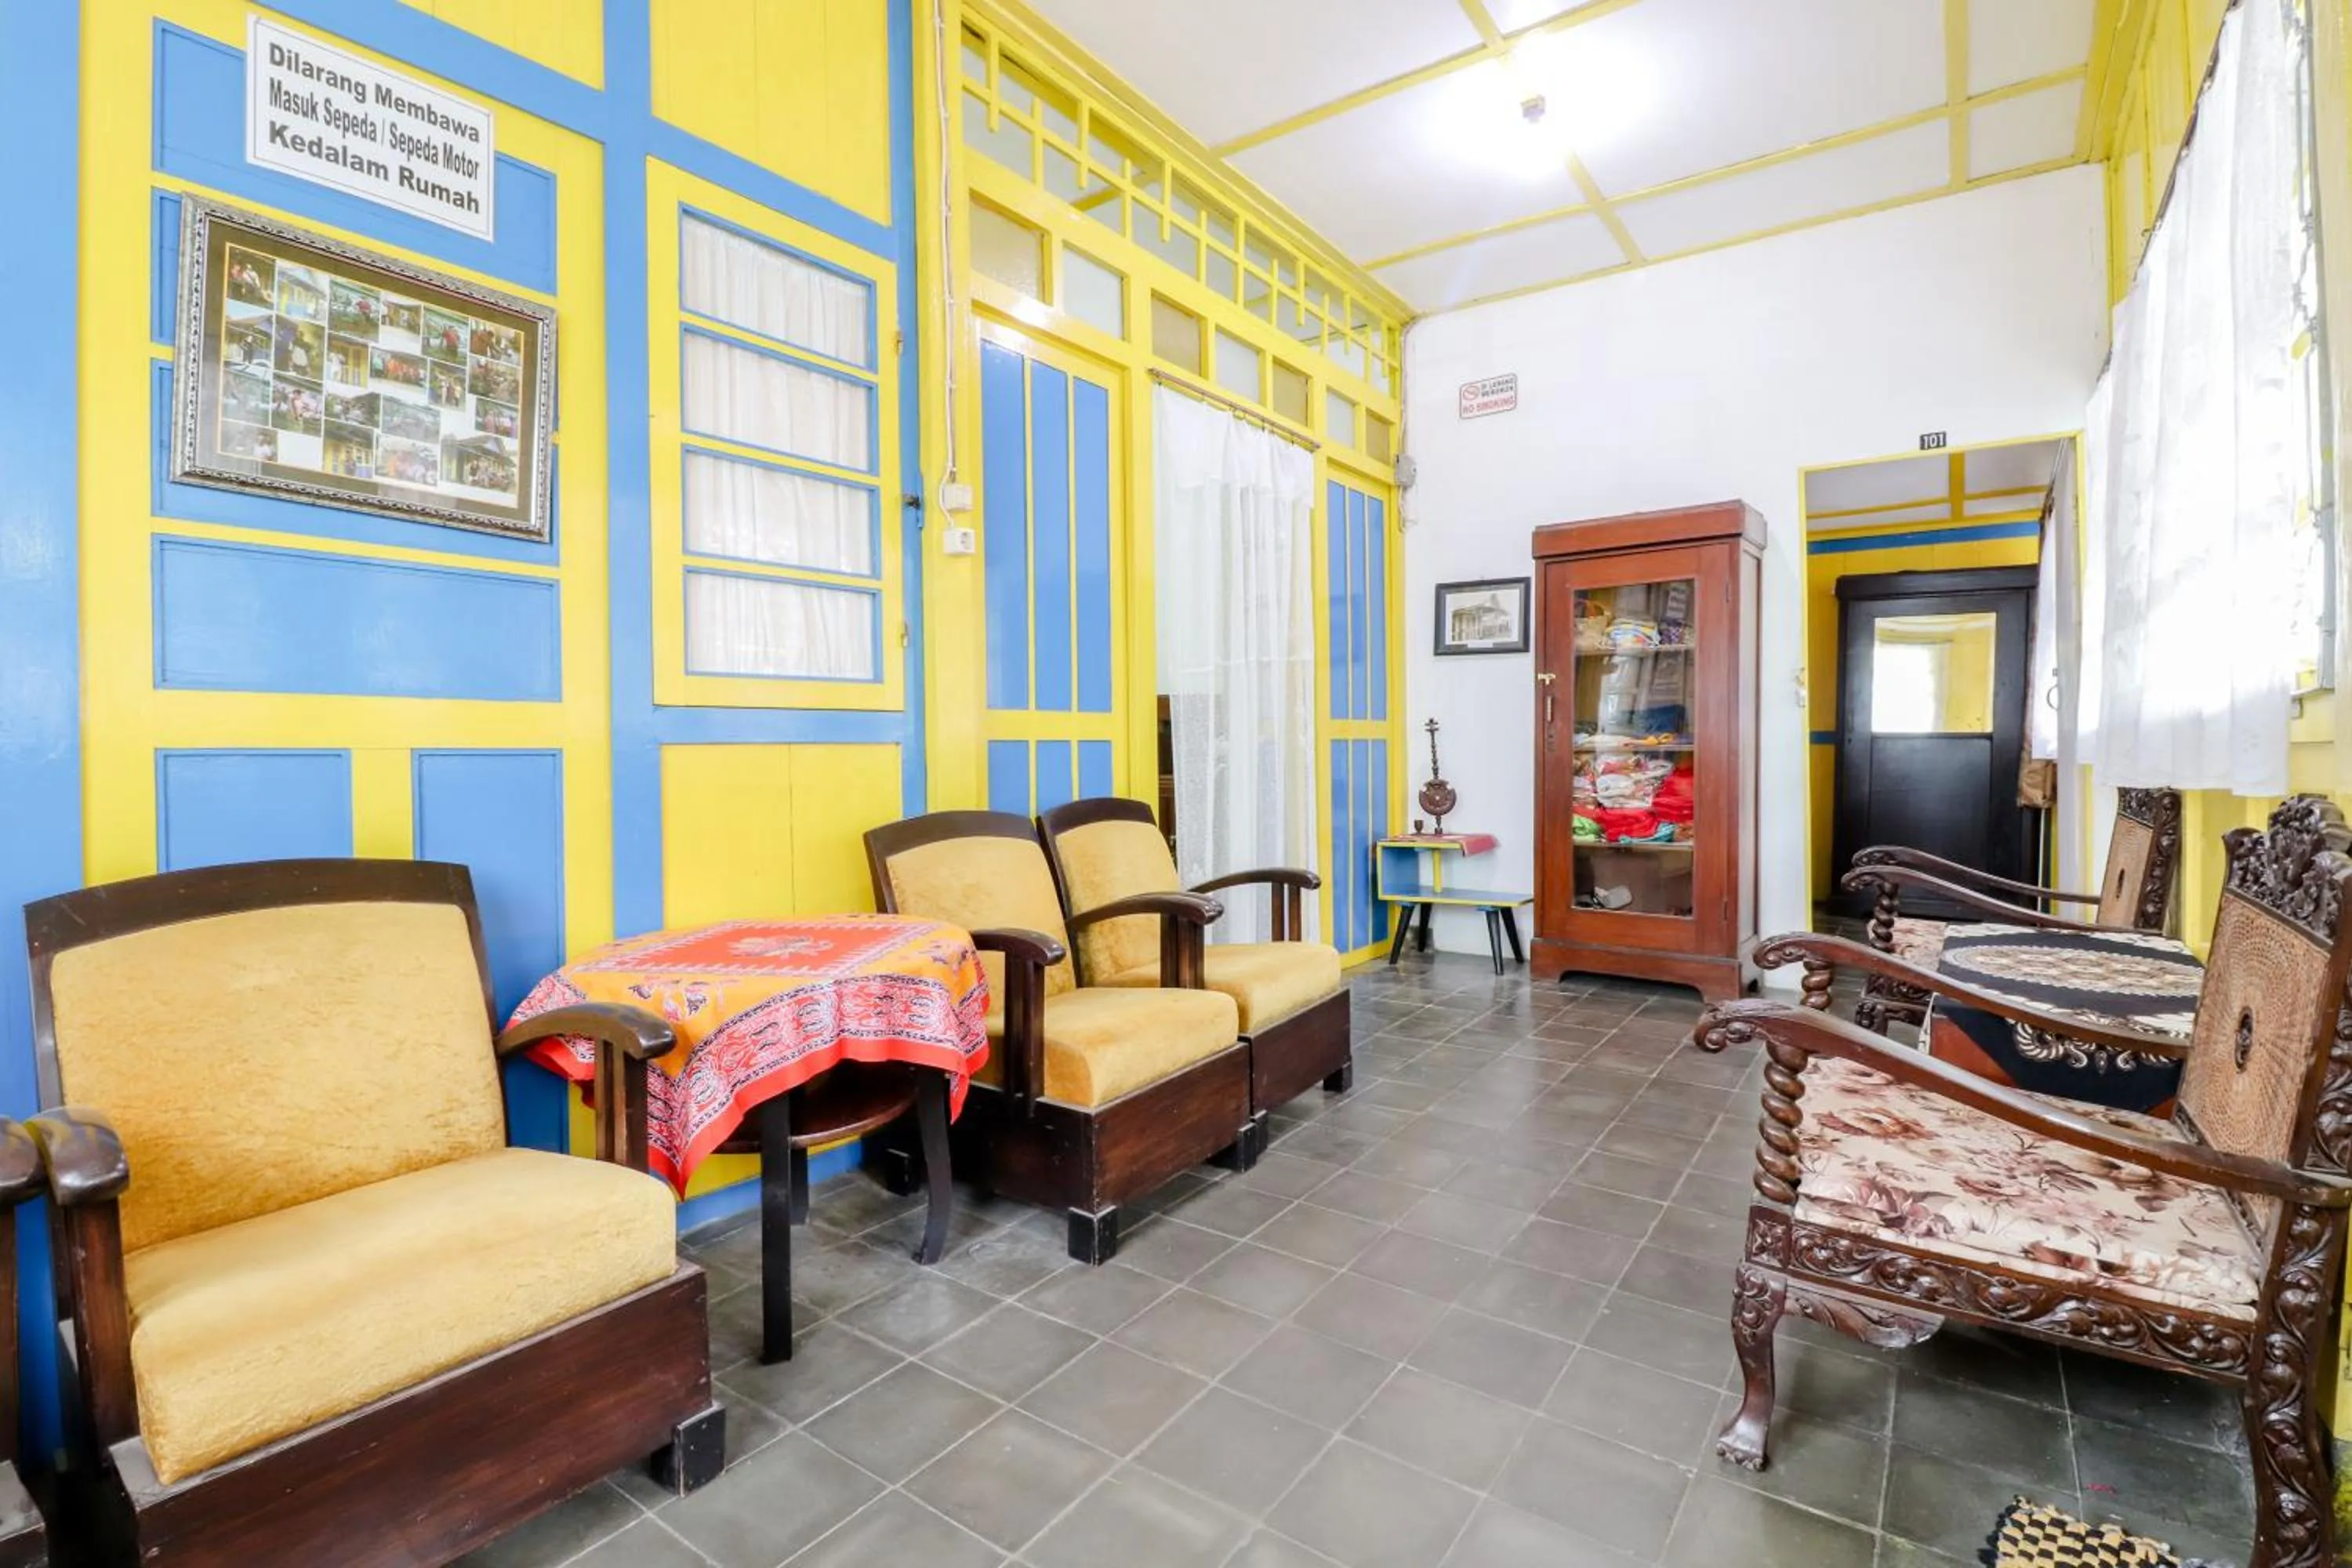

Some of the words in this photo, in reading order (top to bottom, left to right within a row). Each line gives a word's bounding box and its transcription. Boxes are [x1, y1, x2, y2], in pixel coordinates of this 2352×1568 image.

[269, 42, 366, 103] Dilarang
[375, 82, 479, 143] Membawa
[269, 77, 319, 123] Masuk
[324, 97, 377, 143] Sepeda
[390, 122, 438, 165] Sepeda
[443, 142, 479, 181] Motor
[269, 120, 389, 182] Kedalam
[399, 165, 479, 214] Rumah
[1923, 433, 1944, 450] 101
